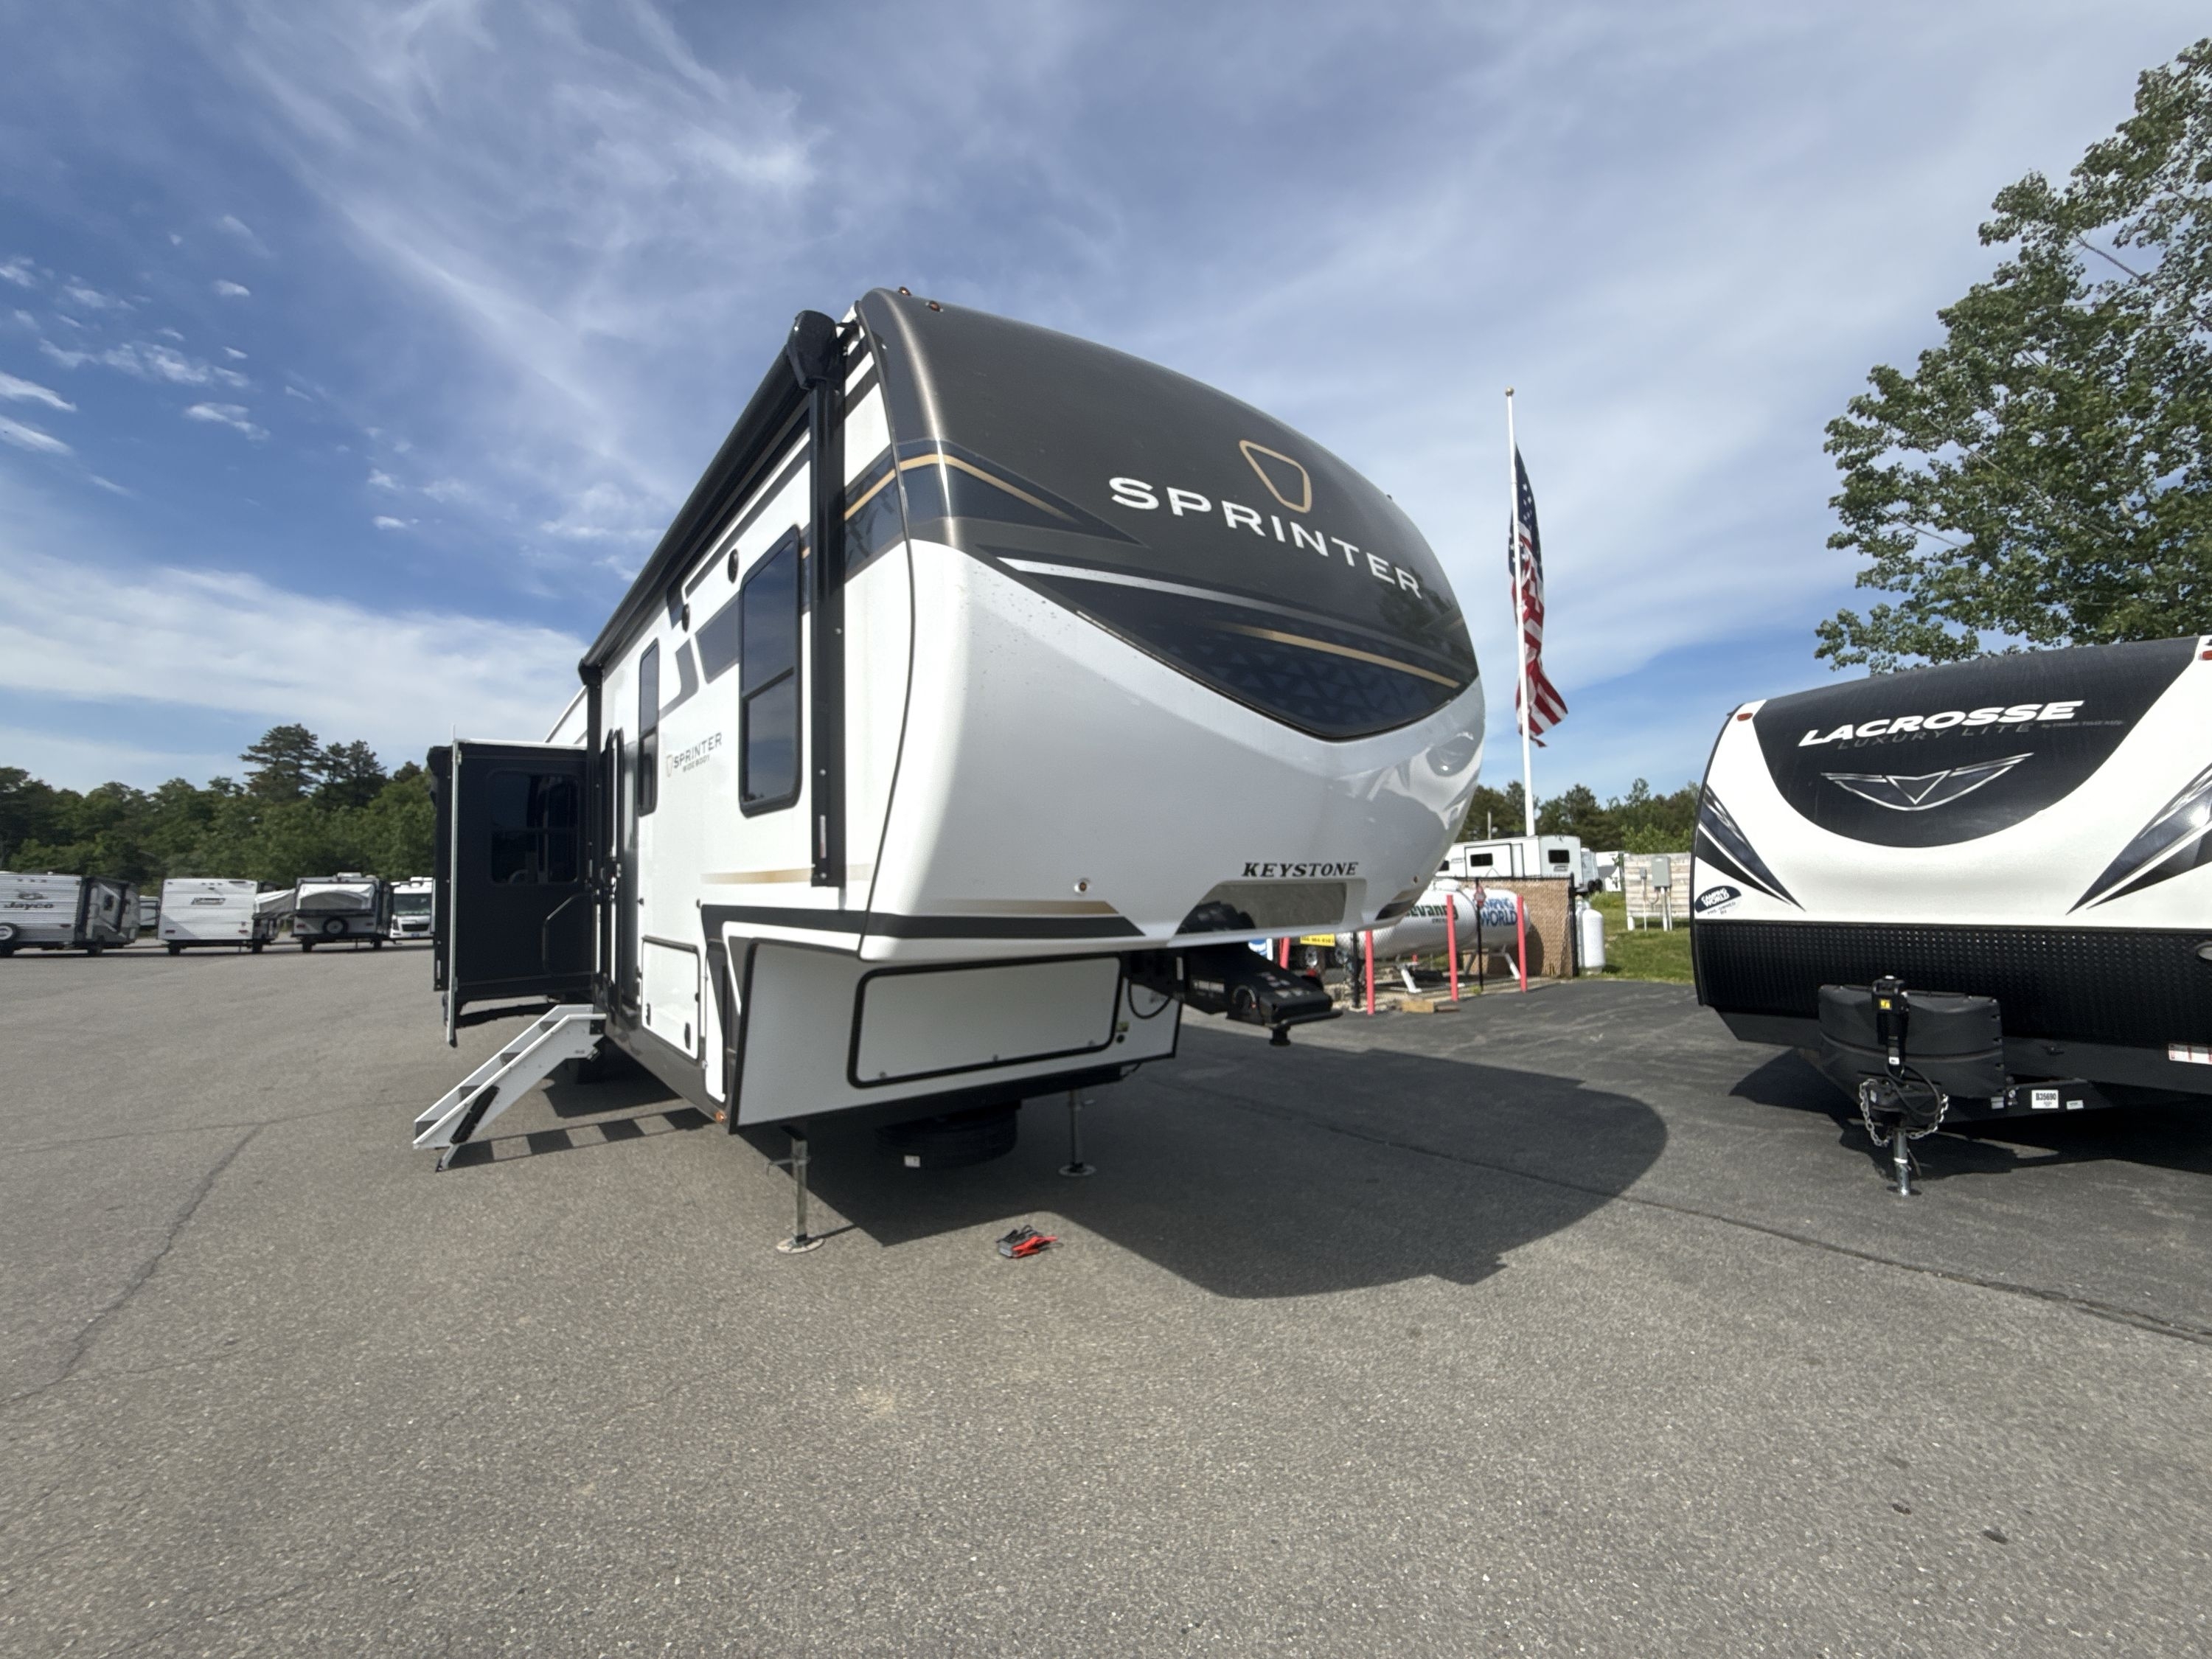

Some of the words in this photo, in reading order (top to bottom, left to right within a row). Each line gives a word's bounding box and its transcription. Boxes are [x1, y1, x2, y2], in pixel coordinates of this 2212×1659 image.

[1109, 477, 1422, 599] SPRINTER
[1798, 700, 2084, 746] LACROSSE
[1837, 729, 1947, 750] LUXURY
[1961, 723, 2034, 737] LITE
[673, 731, 723, 768] SPRINTER
[1241, 861, 1359, 877] KEYSTONE
